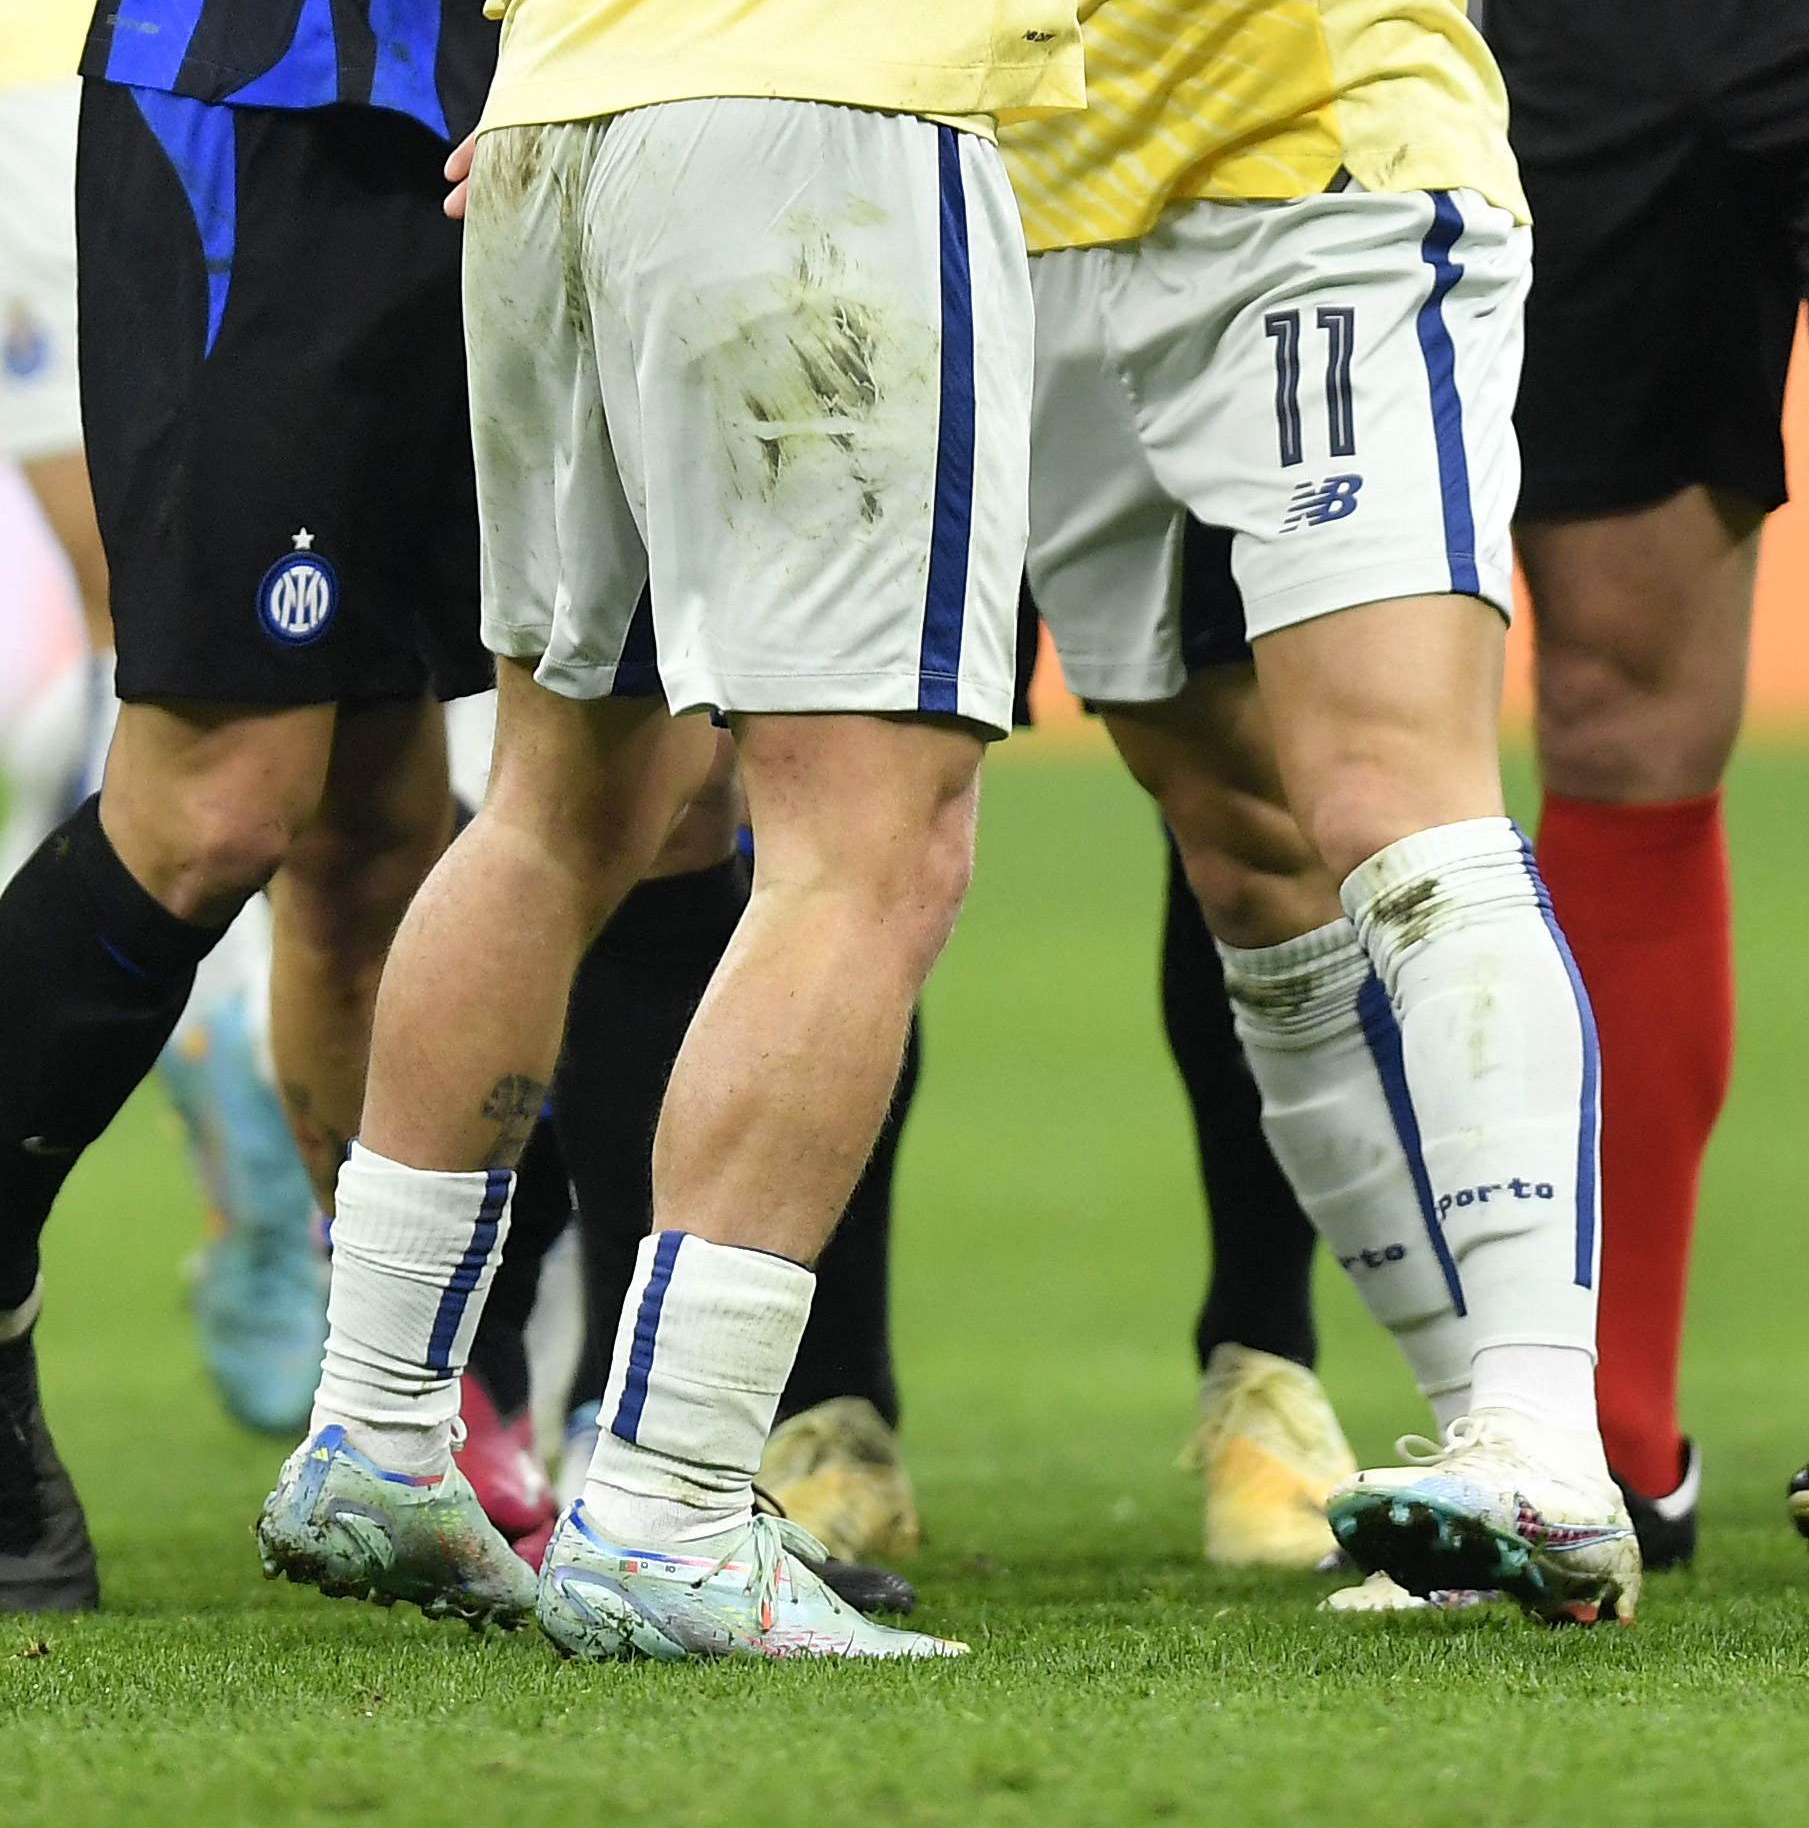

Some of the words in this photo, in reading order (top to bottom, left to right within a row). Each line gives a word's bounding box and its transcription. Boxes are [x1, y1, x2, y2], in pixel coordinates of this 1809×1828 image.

[1264, 306, 1356, 468] 11
[1436, 1176, 1555, 1221] porto
[1339, 1242, 1406, 1269] rto
